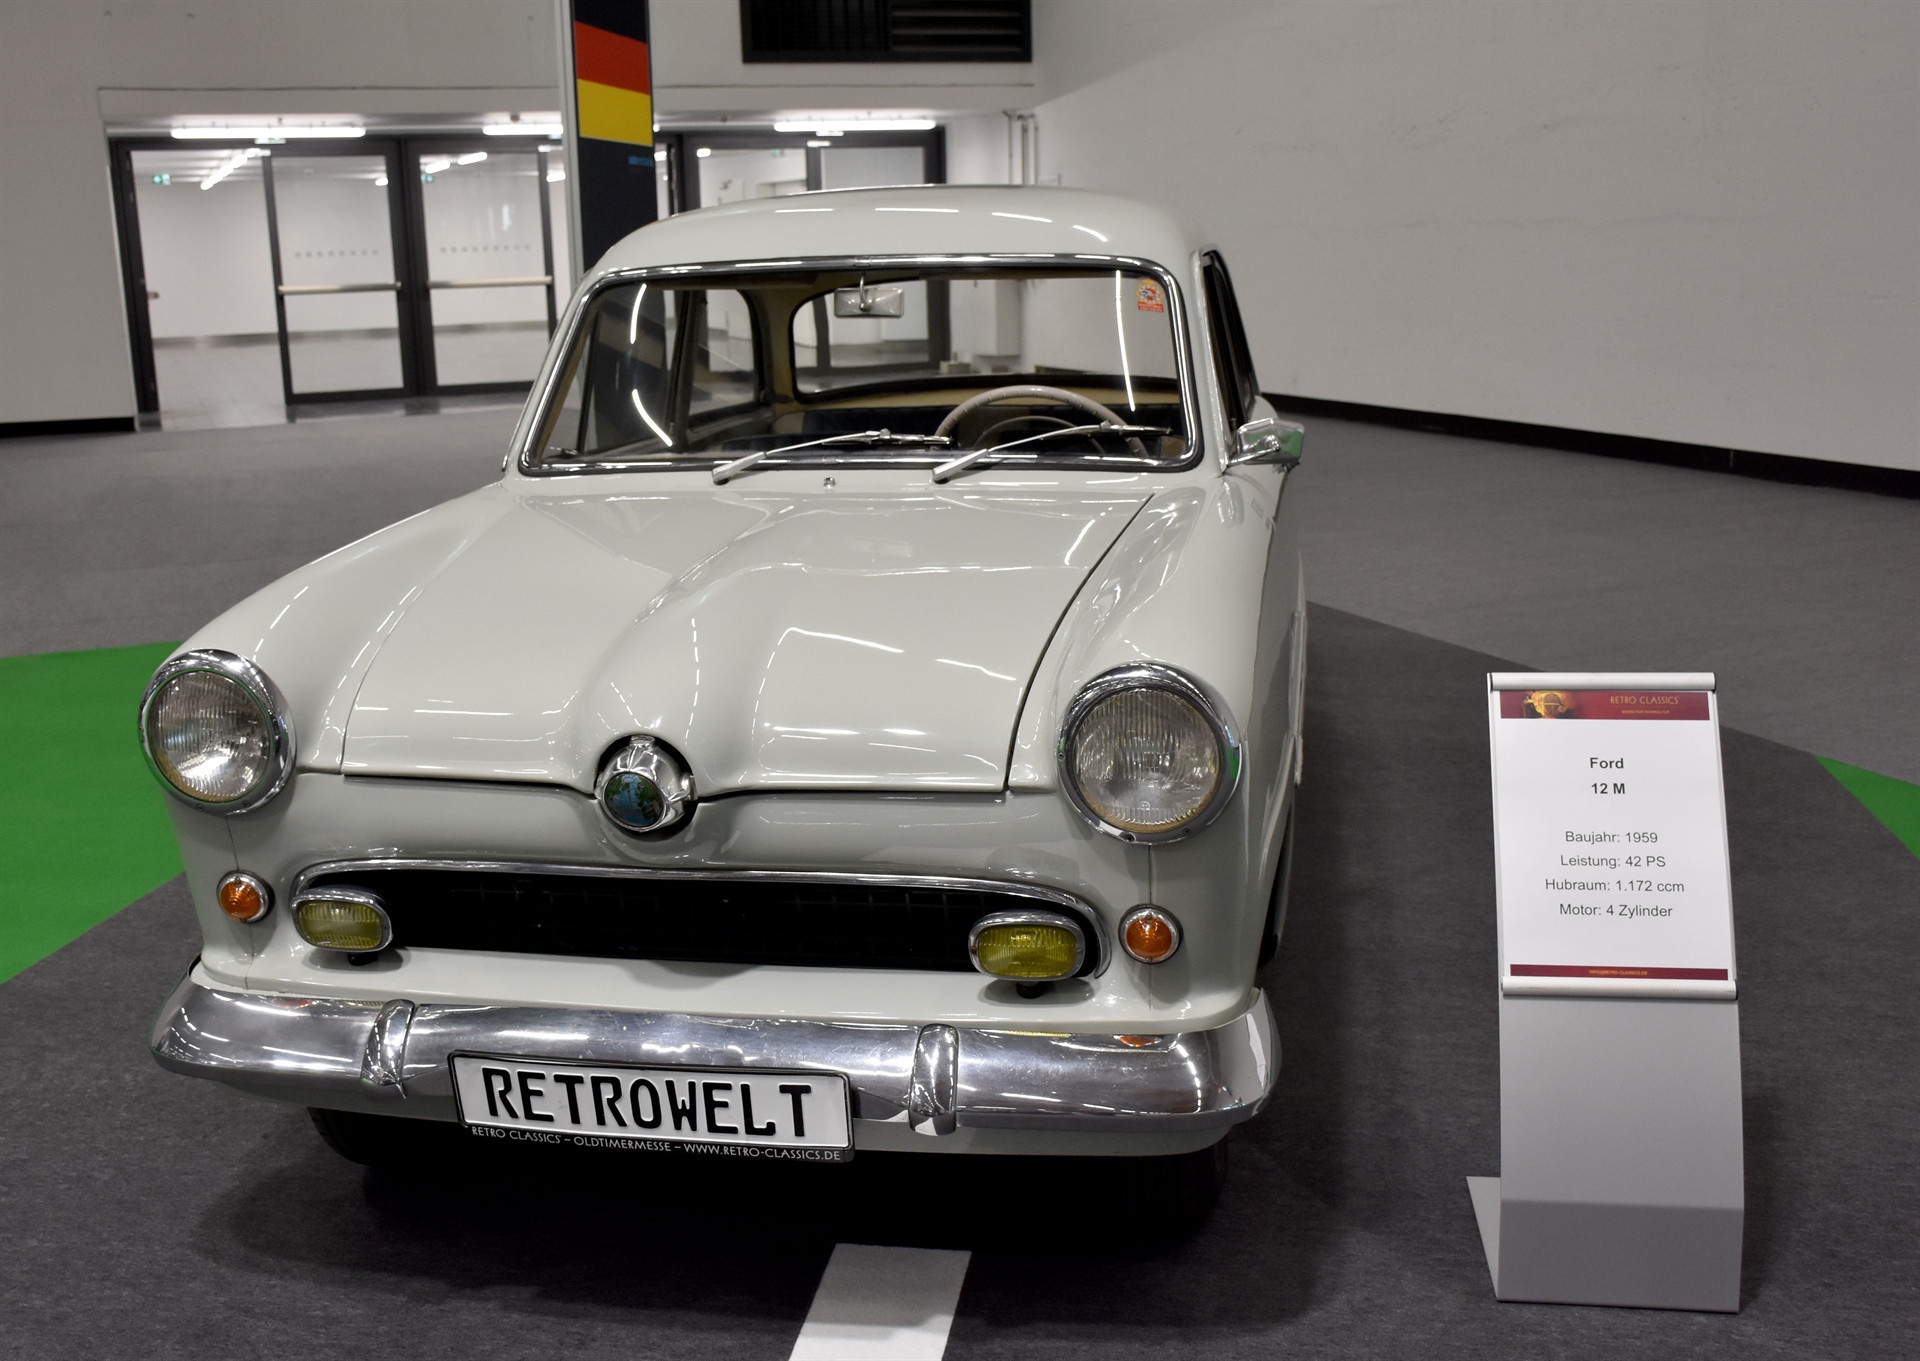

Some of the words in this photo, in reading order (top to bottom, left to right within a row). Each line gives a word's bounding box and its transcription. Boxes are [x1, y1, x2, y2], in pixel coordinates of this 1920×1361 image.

[1610, 695, 1637, 704] RETRO
[1639, 696, 1679, 705] CLASSICS
[1589, 757, 1625, 769] Ford
[1591, 783, 1608, 795] 12
[1613, 783, 1626, 795] M
[1565, 831, 1620, 845] Baujahr:
[1625, 832, 1658, 843] 1959
[1560, 855, 1621, 869] Leistung:
[1625, 856, 1642, 867] 42
[1646, 856, 1666, 867] PS
[1545, 879, 1611, 891] Hubraum:
[1615, 880, 1653, 892] 1.172
[1657, 884, 1685, 892] ccm
[1559, 904, 1602, 916] Motor:
[1606, 905, 1615, 916] 4
[1618, 905, 1673, 919] Zylinder
[481, 1066, 812, 1137] RETROWELT
[472, 1126, 506, 1138] RETRO
[509, 1130, 562, 1144] CLASSICS
[573, 1136, 671, 1151] OLDTIMERMESSE
[684, 1143, 841, 1160] WWW.RETRO-CLASSICS.DE
